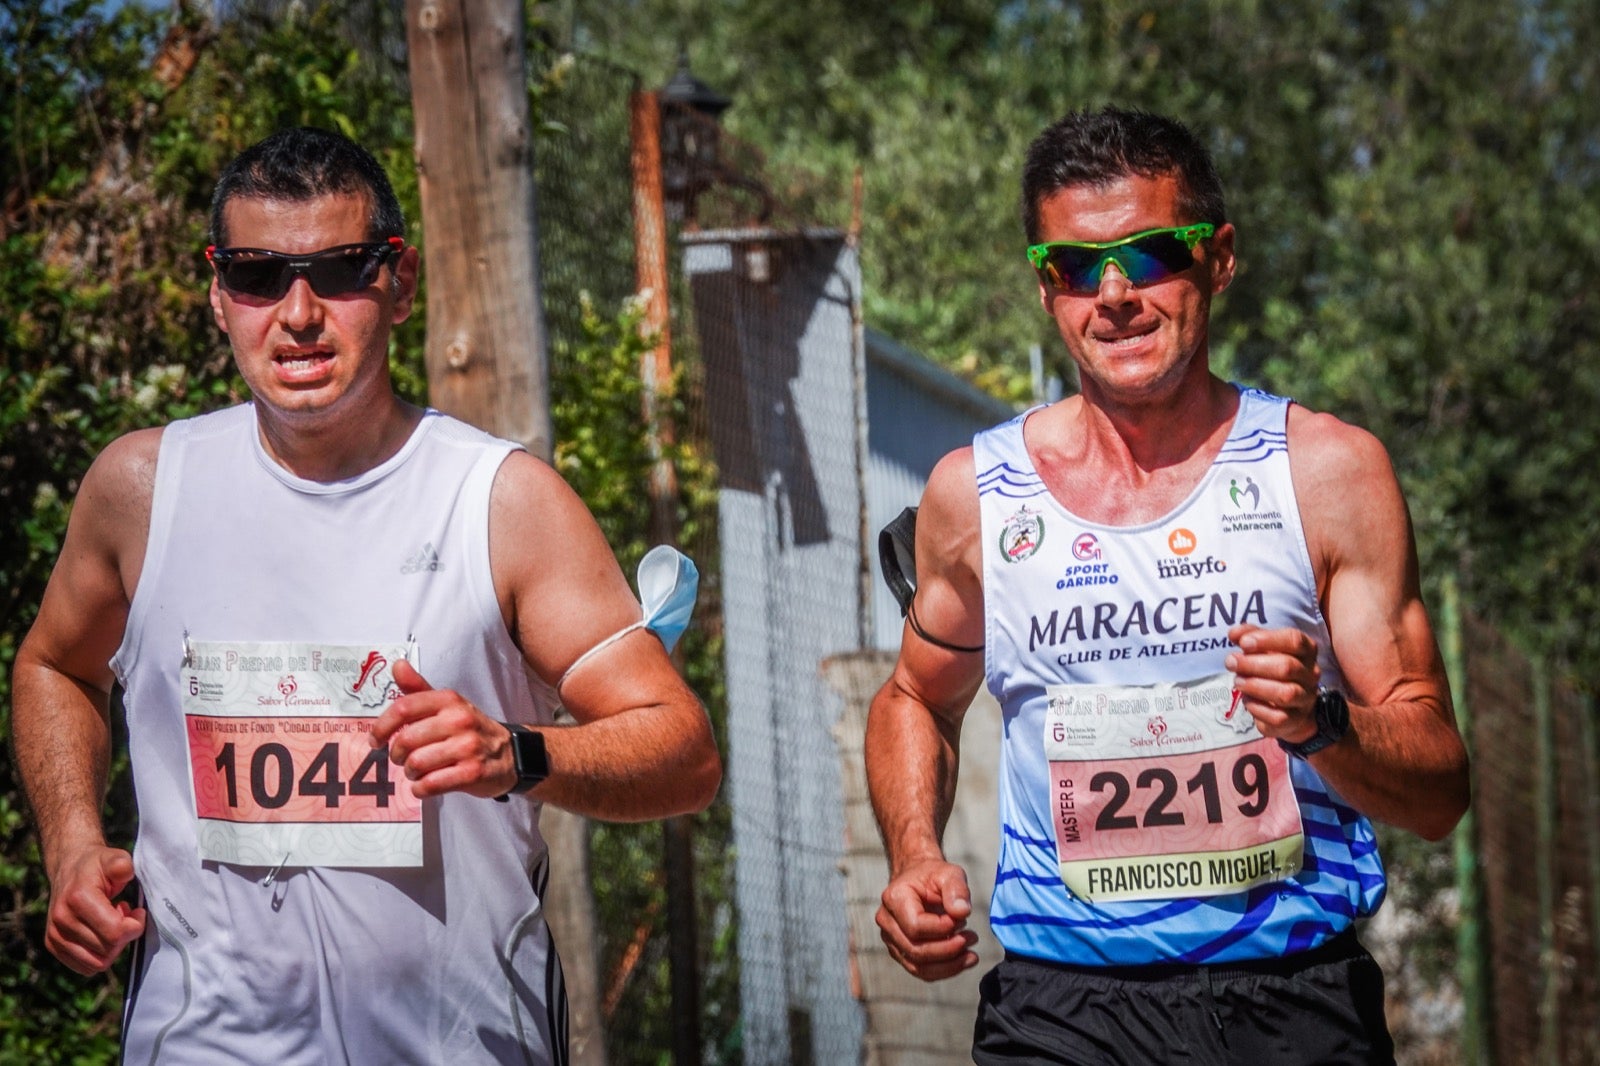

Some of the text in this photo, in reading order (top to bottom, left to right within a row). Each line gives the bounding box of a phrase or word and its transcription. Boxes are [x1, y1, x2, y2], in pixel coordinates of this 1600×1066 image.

[1222, 511, 1282, 523] Ayuntamiento
[1232, 521, 1283, 532] Maracena
[1065, 563, 1109, 577] SPORT
[1158, 555, 1227, 580] mayfo
[1056, 574, 1119, 590] GARRIDO
[1029, 589, 1268, 653] MARACENA
[1057, 649, 1102, 667] CLUB
[1108, 648, 1132, 661] DE
[250, 722, 275, 733] FONDO
[1130, 733, 1203, 748] Sabor Granada
[215, 742, 395, 809] 1044
[1089, 753, 1270, 831] 2219
[1059, 778, 1081, 843] MASTER B
[1087, 849, 1282, 894] FRANCISCO MIGUEL
